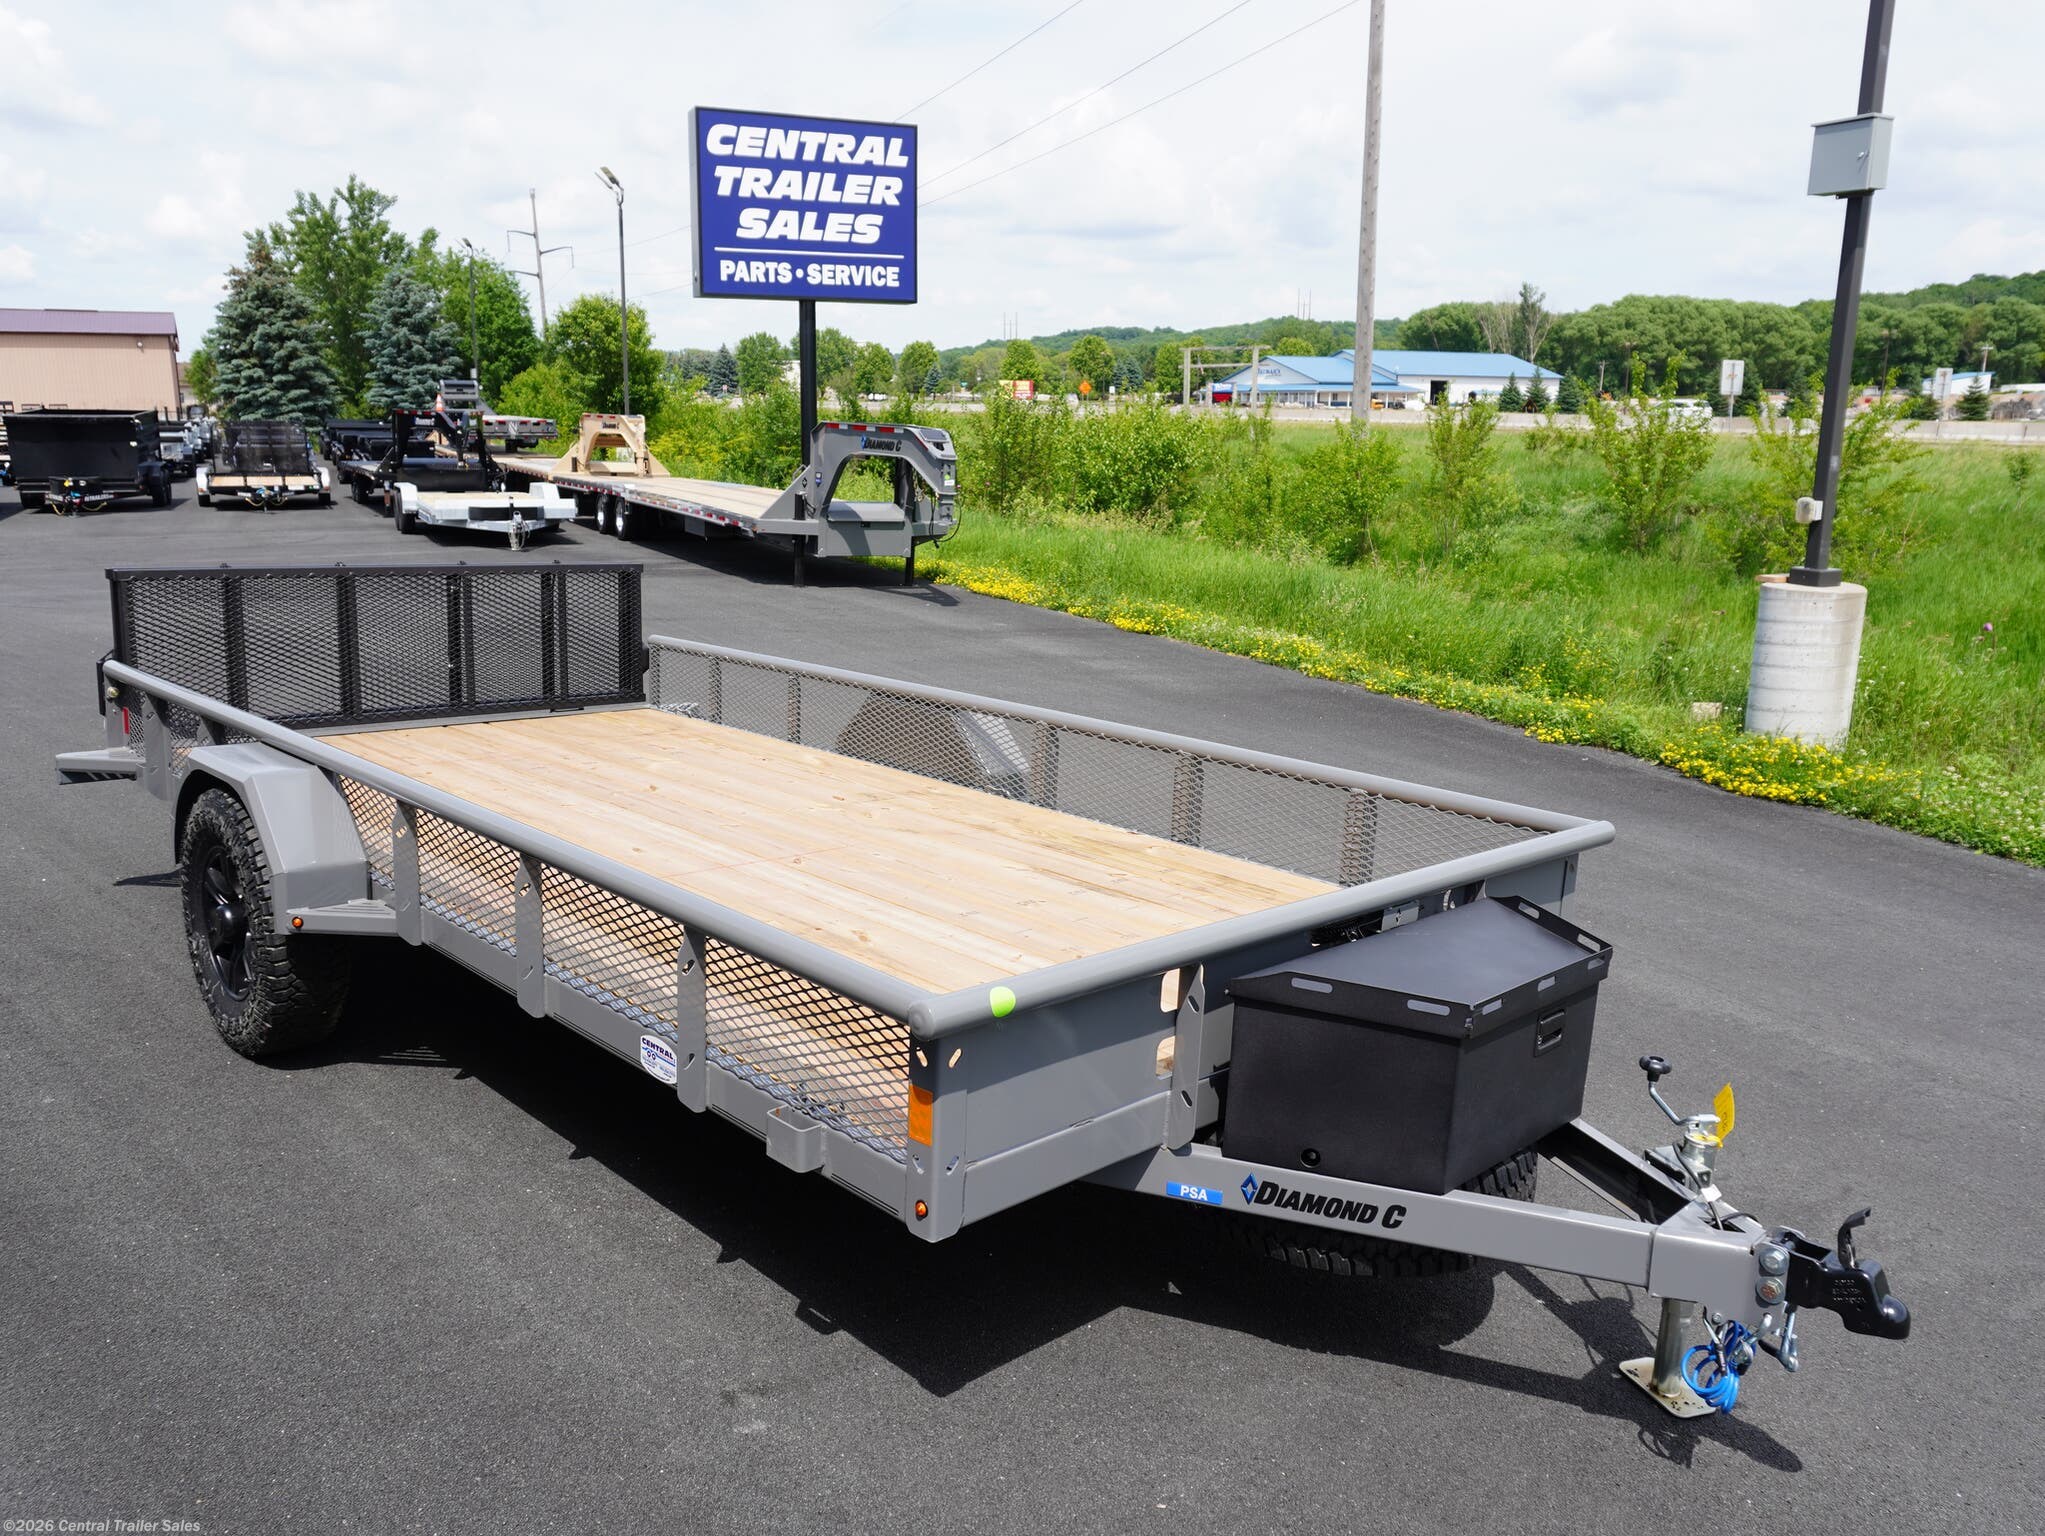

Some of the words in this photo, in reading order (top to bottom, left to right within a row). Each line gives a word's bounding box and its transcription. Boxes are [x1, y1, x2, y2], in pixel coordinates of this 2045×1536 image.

[706, 123, 909, 168] CENTRAL
[714, 165, 904, 206] TRAILER
[736, 207, 884, 244] SALES
[720, 259, 793, 284] PARTS
[806, 263, 900, 287] SERVICE
[642, 1037, 674, 1060] CENTRAL
[1180, 1184, 1208, 1202] PSA
[1254, 1181, 1379, 1224] DIAMOND
[1381, 1204, 1407, 1229] C
